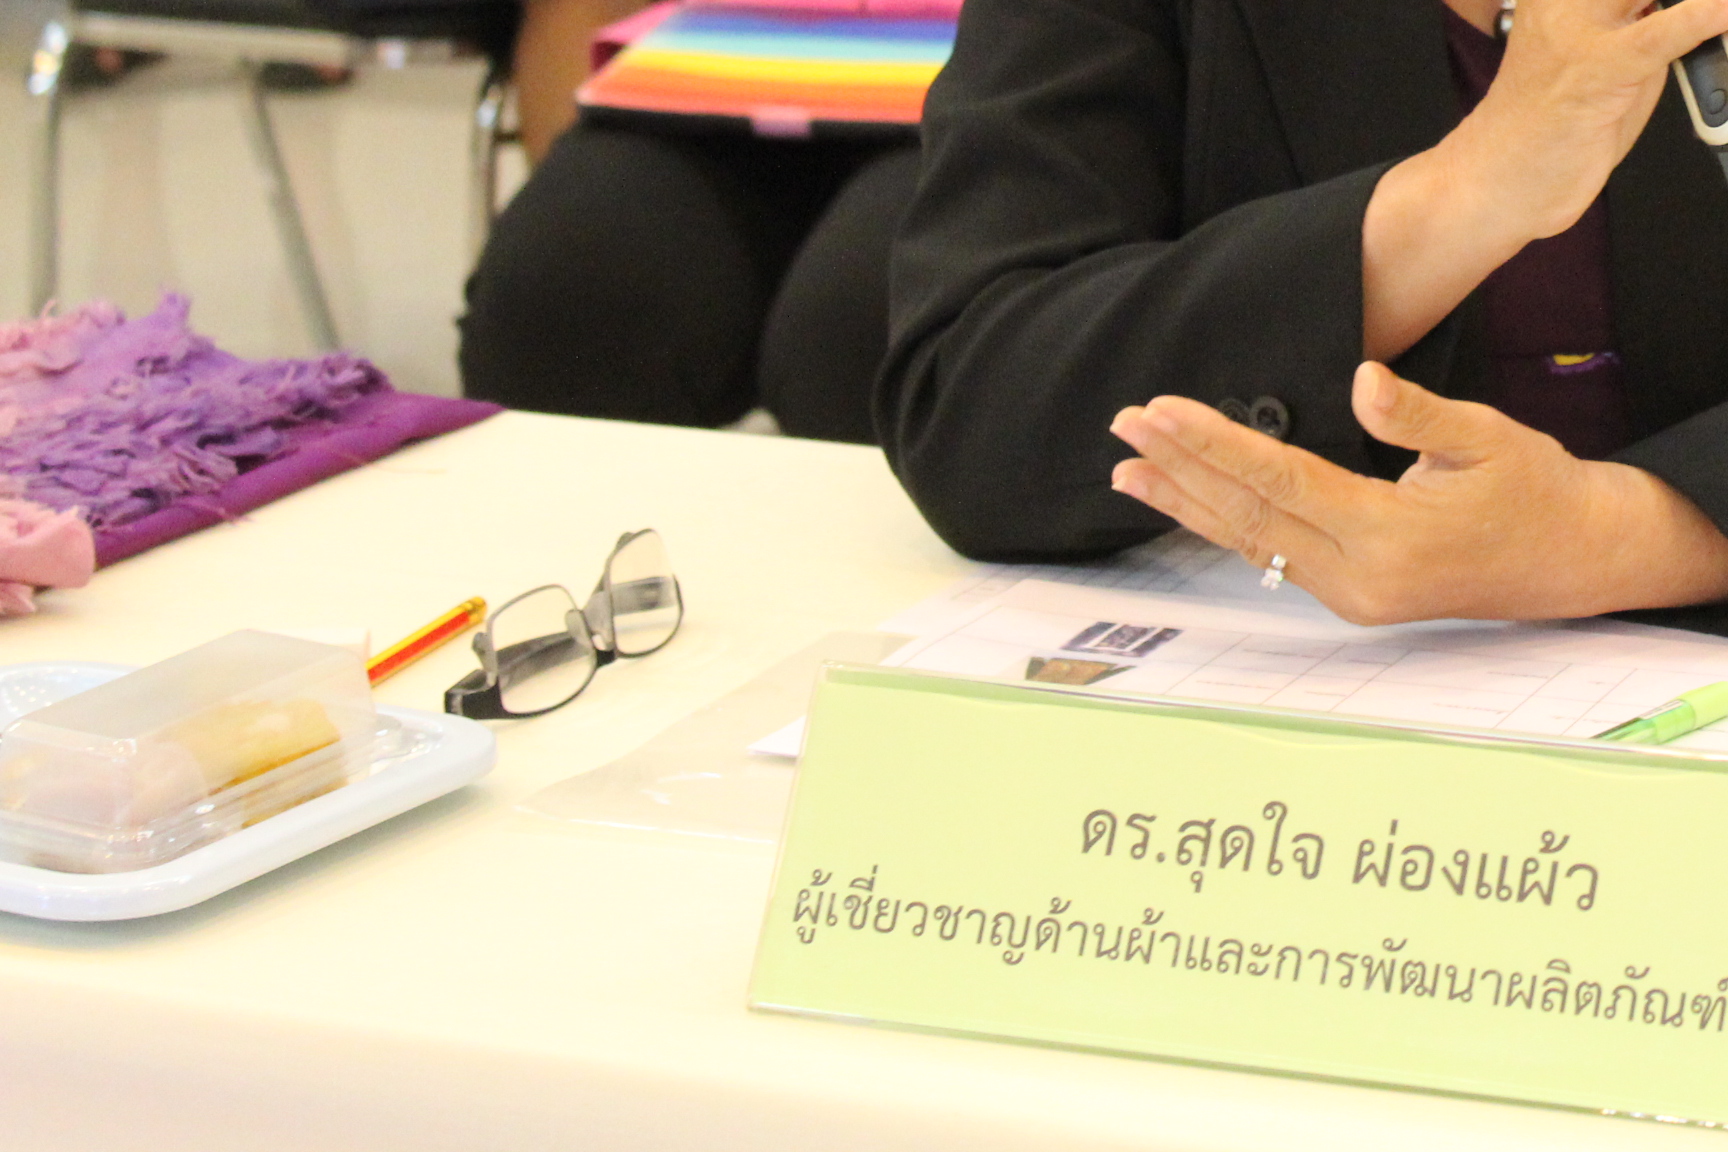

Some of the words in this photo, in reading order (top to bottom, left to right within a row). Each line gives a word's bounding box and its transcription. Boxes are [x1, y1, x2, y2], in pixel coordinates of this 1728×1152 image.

[1081, 799, 1326, 894] ดร.สุดใจ
[1351, 818, 1599, 912] ผ่องแผ้ว
